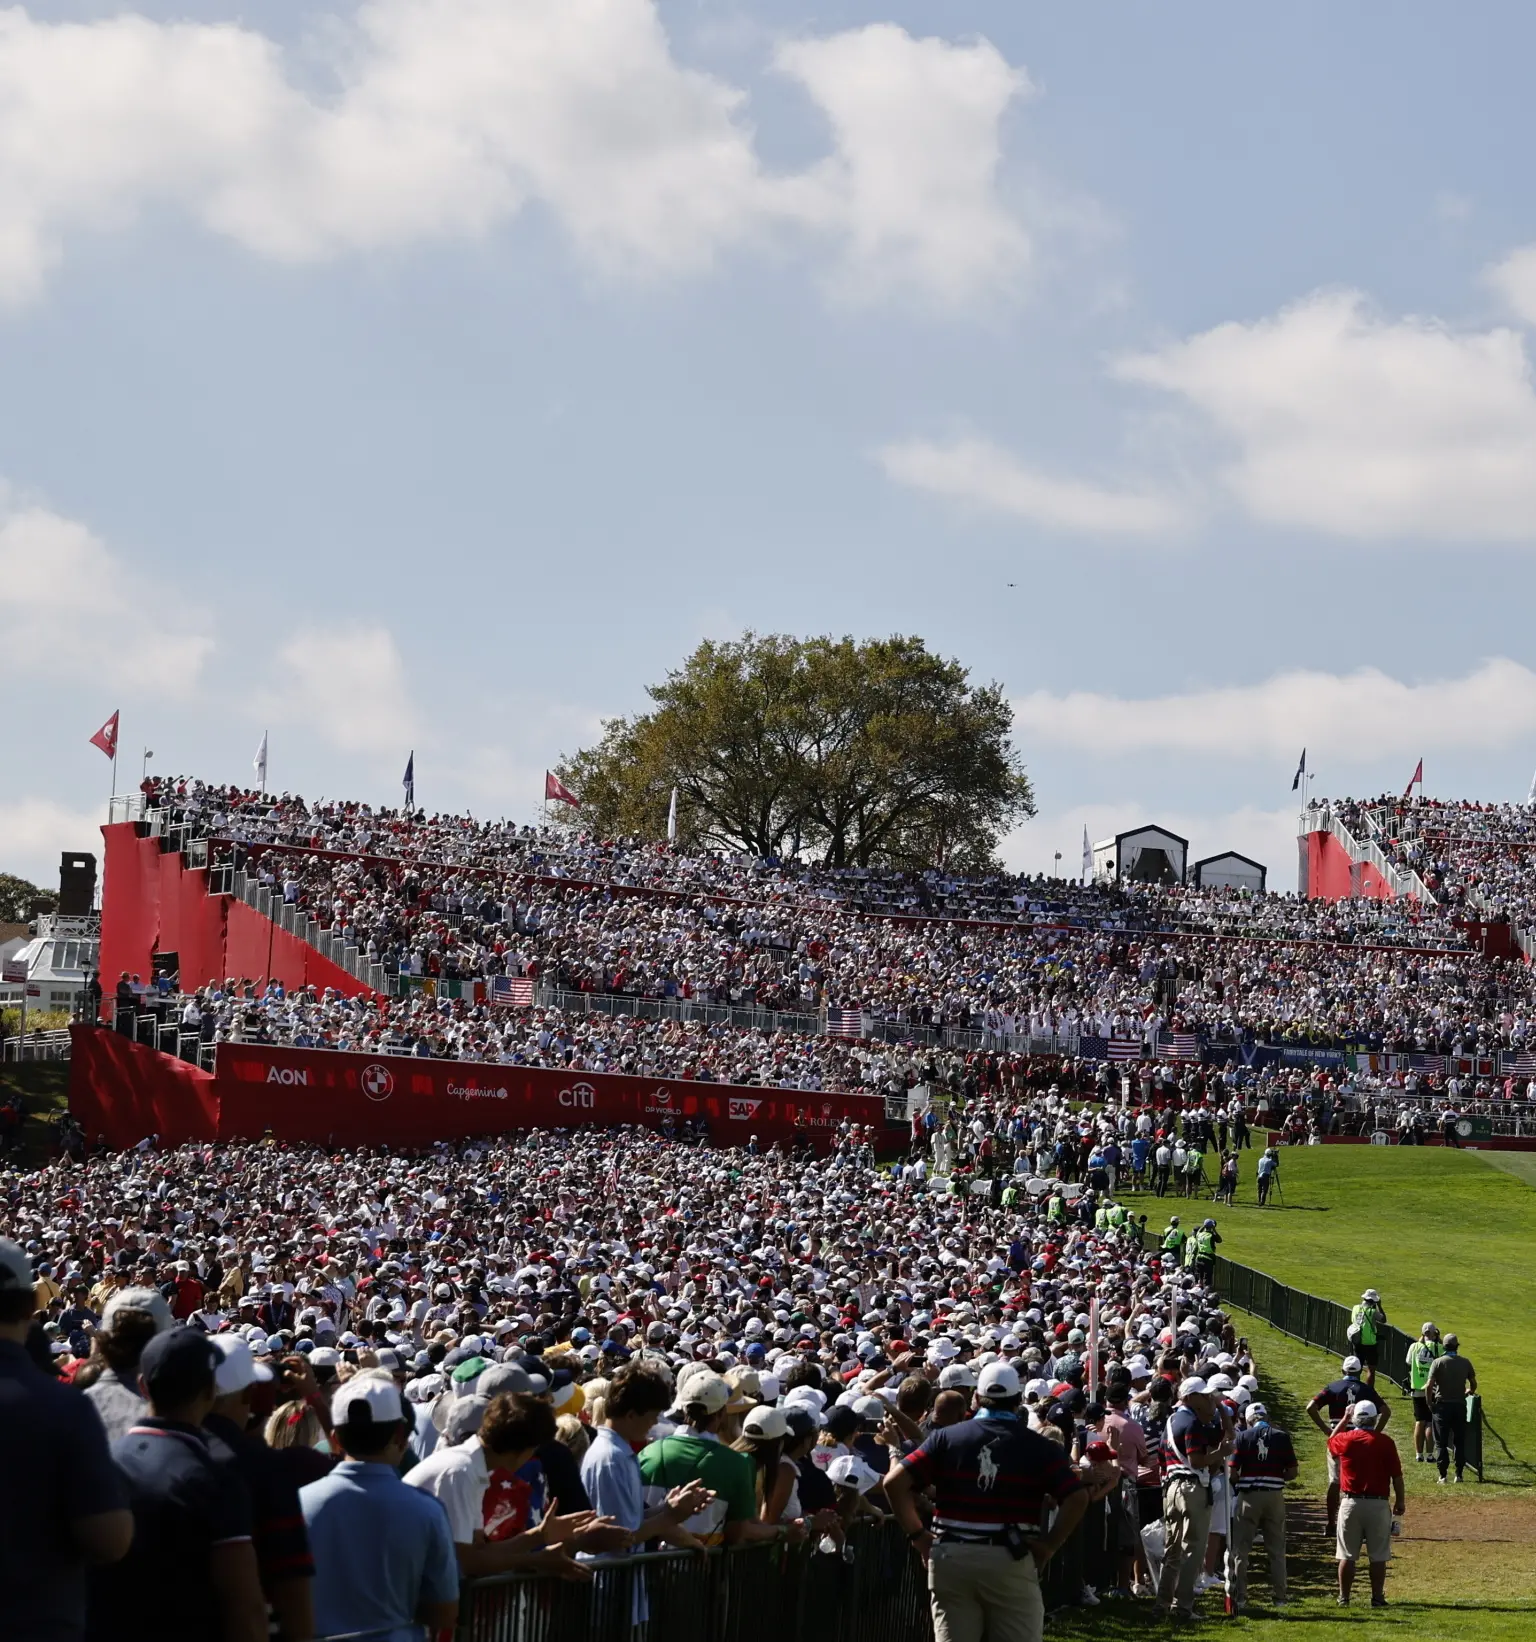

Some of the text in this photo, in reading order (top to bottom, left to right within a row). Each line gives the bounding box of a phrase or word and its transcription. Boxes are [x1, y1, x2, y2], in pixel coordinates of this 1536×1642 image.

[266, 1065, 308, 1086] AON
[447, 1082, 497, 1101] Capgemini
[558, 1082, 595, 1108] citi
[656, 1107, 682, 1115] WORLD
[730, 1101, 755, 1116] SAP
[810, 1117, 843, 1127] ROLEX
